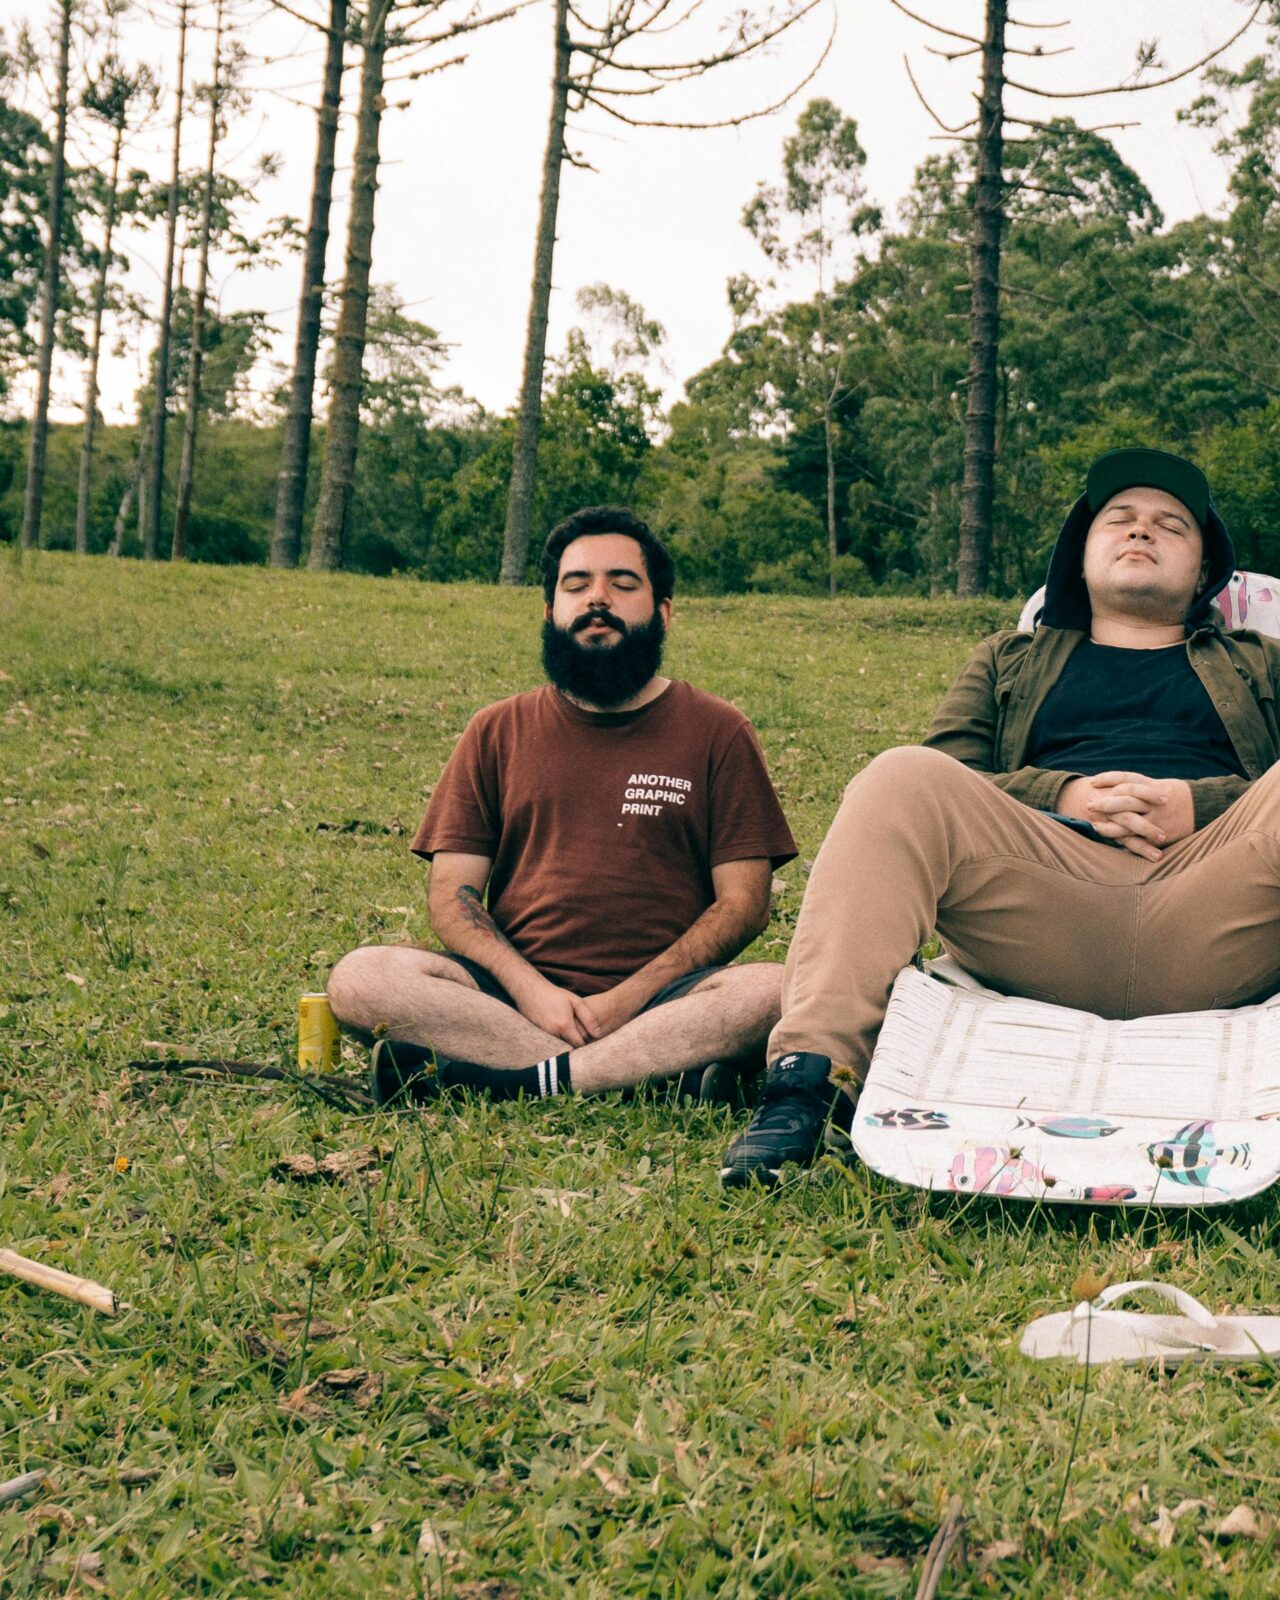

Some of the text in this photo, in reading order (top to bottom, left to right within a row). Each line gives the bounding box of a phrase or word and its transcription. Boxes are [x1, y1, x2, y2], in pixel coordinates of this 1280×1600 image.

[627, 774, 692, 791] ANOTHER
[624, 788, 686, 805] GRAPHIC
[621, 803, 662, 816] PRINT
